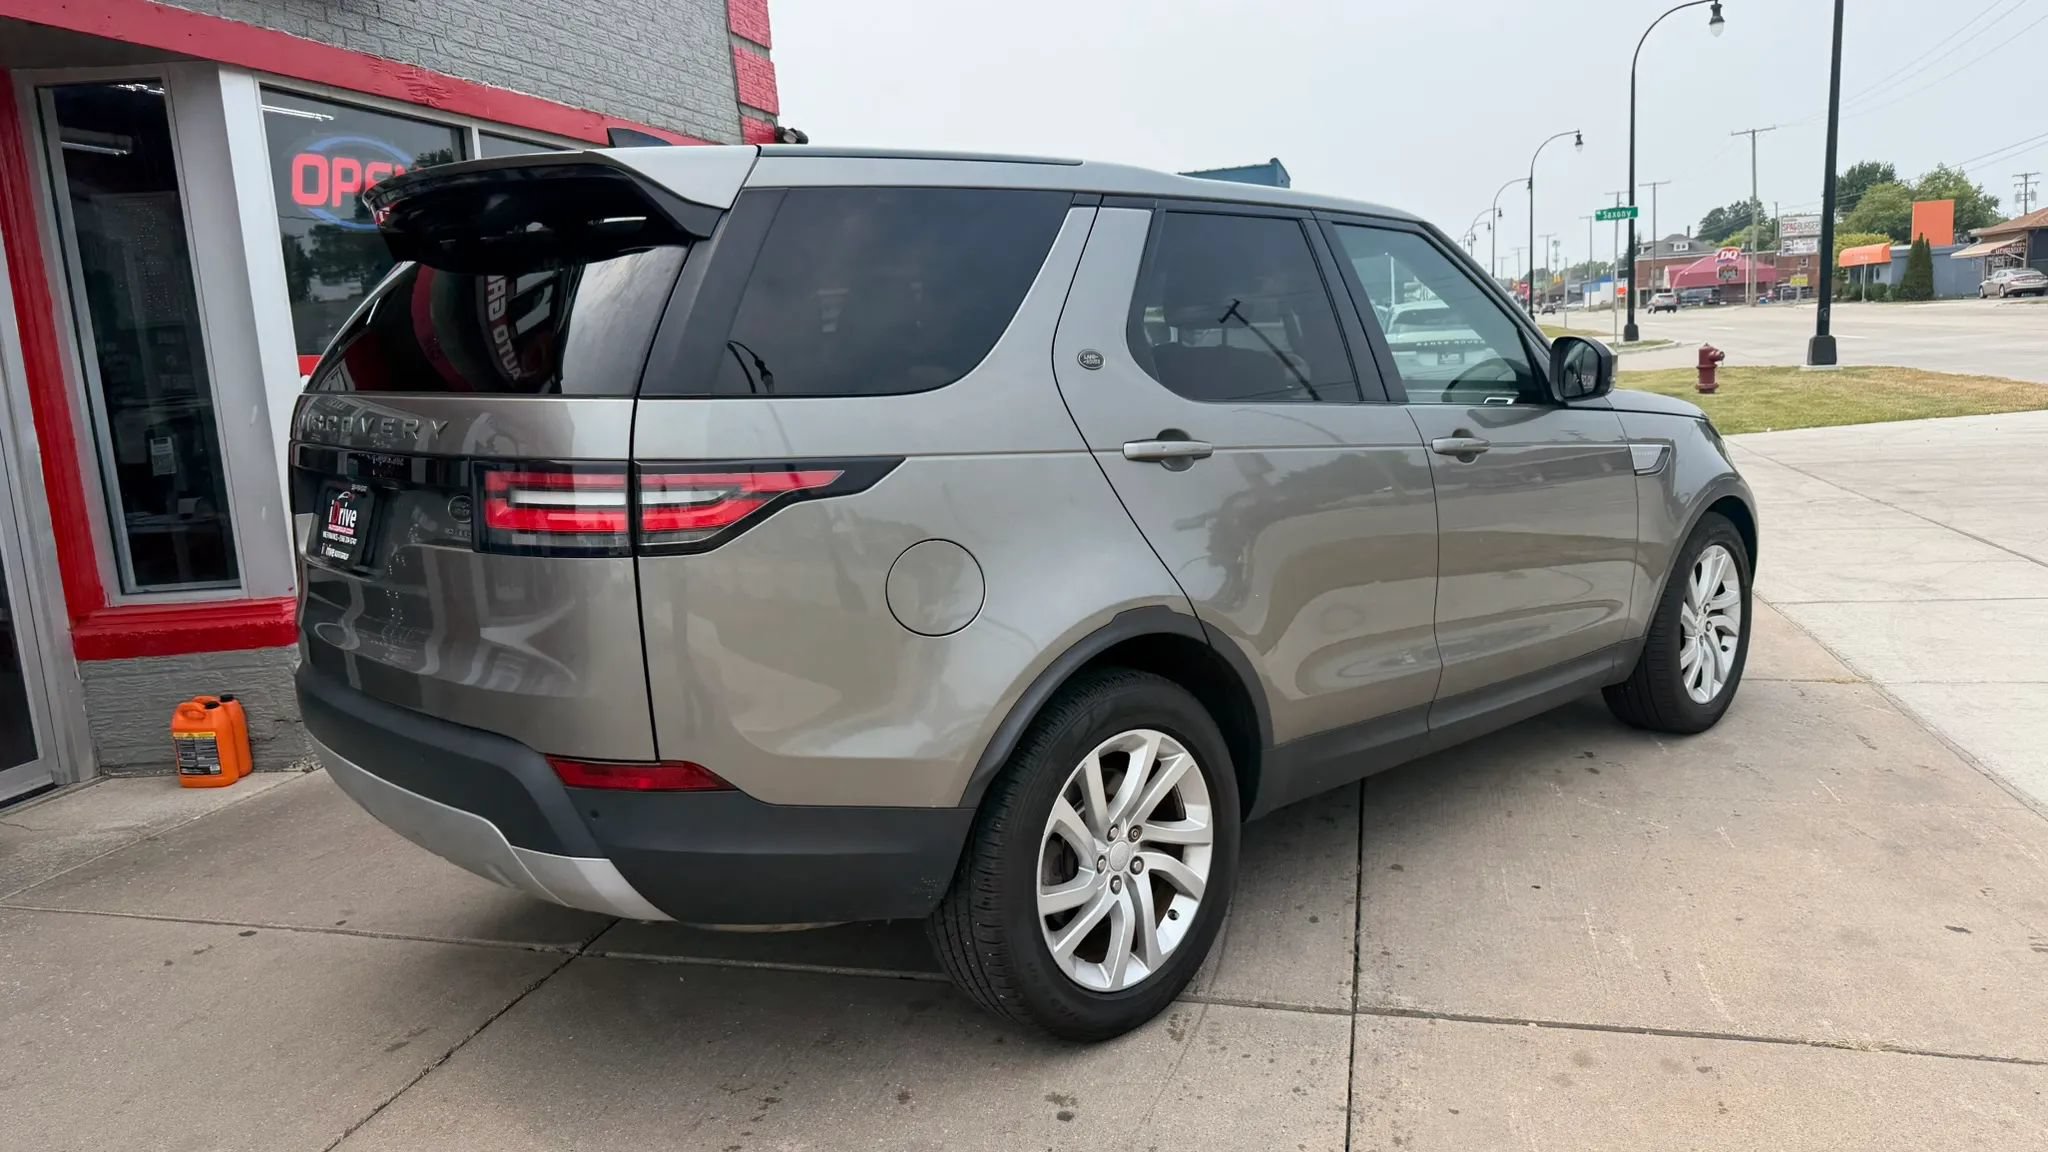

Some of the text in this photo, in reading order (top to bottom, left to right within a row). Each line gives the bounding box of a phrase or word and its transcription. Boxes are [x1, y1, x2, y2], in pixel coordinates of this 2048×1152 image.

[292, 153, 406, 207] OPE
[1603, 210, 1632, 219] Saxony
[1720, 250, 1738, 260] DQ
[328, 499, 357, 528] iDrive
